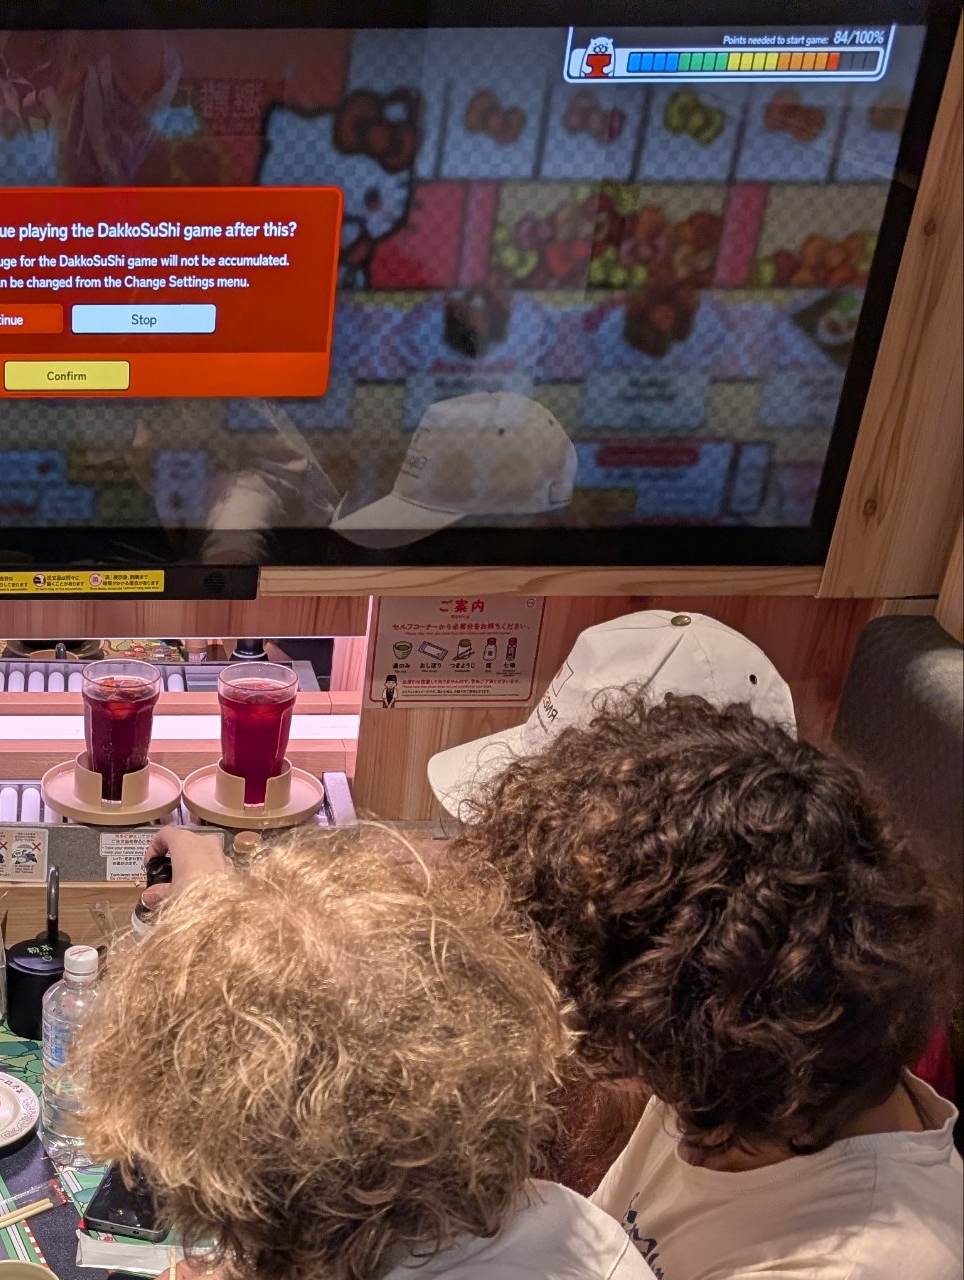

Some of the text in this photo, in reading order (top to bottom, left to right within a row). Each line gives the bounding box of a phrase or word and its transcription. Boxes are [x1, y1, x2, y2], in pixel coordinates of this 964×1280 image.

[723, 31, 884, 47] Points needed to start game: 84/100%
[19, 223, 68, 241] playing
[71, 223, 94, 237] the
[97, 222, 180, 238] DakkoSuShi
[184, 226, 222, 241] game
[225, 221, 259, 237] after
[263, 221, 297, 237] this?
[19, 255, 36, 267] for
[38, 255, 56, 267] the
[59, 254, 125, 267] DakkoSuShi
[128, 257, 157, 269] game
[161, 254, 178, 267] will
[181, 256, 199, 266] not
[202, 254, 215, 266] be
[218, 254, 289, 266] accumulated.
[10, 276, 24, 288] be
[26, 276, 72, 290] changed
[75, 276, 102, 288] from
[104, 276, 121, 288] the
[124, 275, 166, 290] Change
[169, 275, 214, 290] Settings
[217, 278, 249, 288] menu.
[131, 313, 157, 328] Stop
[46, 370, 87, 382] Confirm
[439, 599, 485, 613] ご案内
